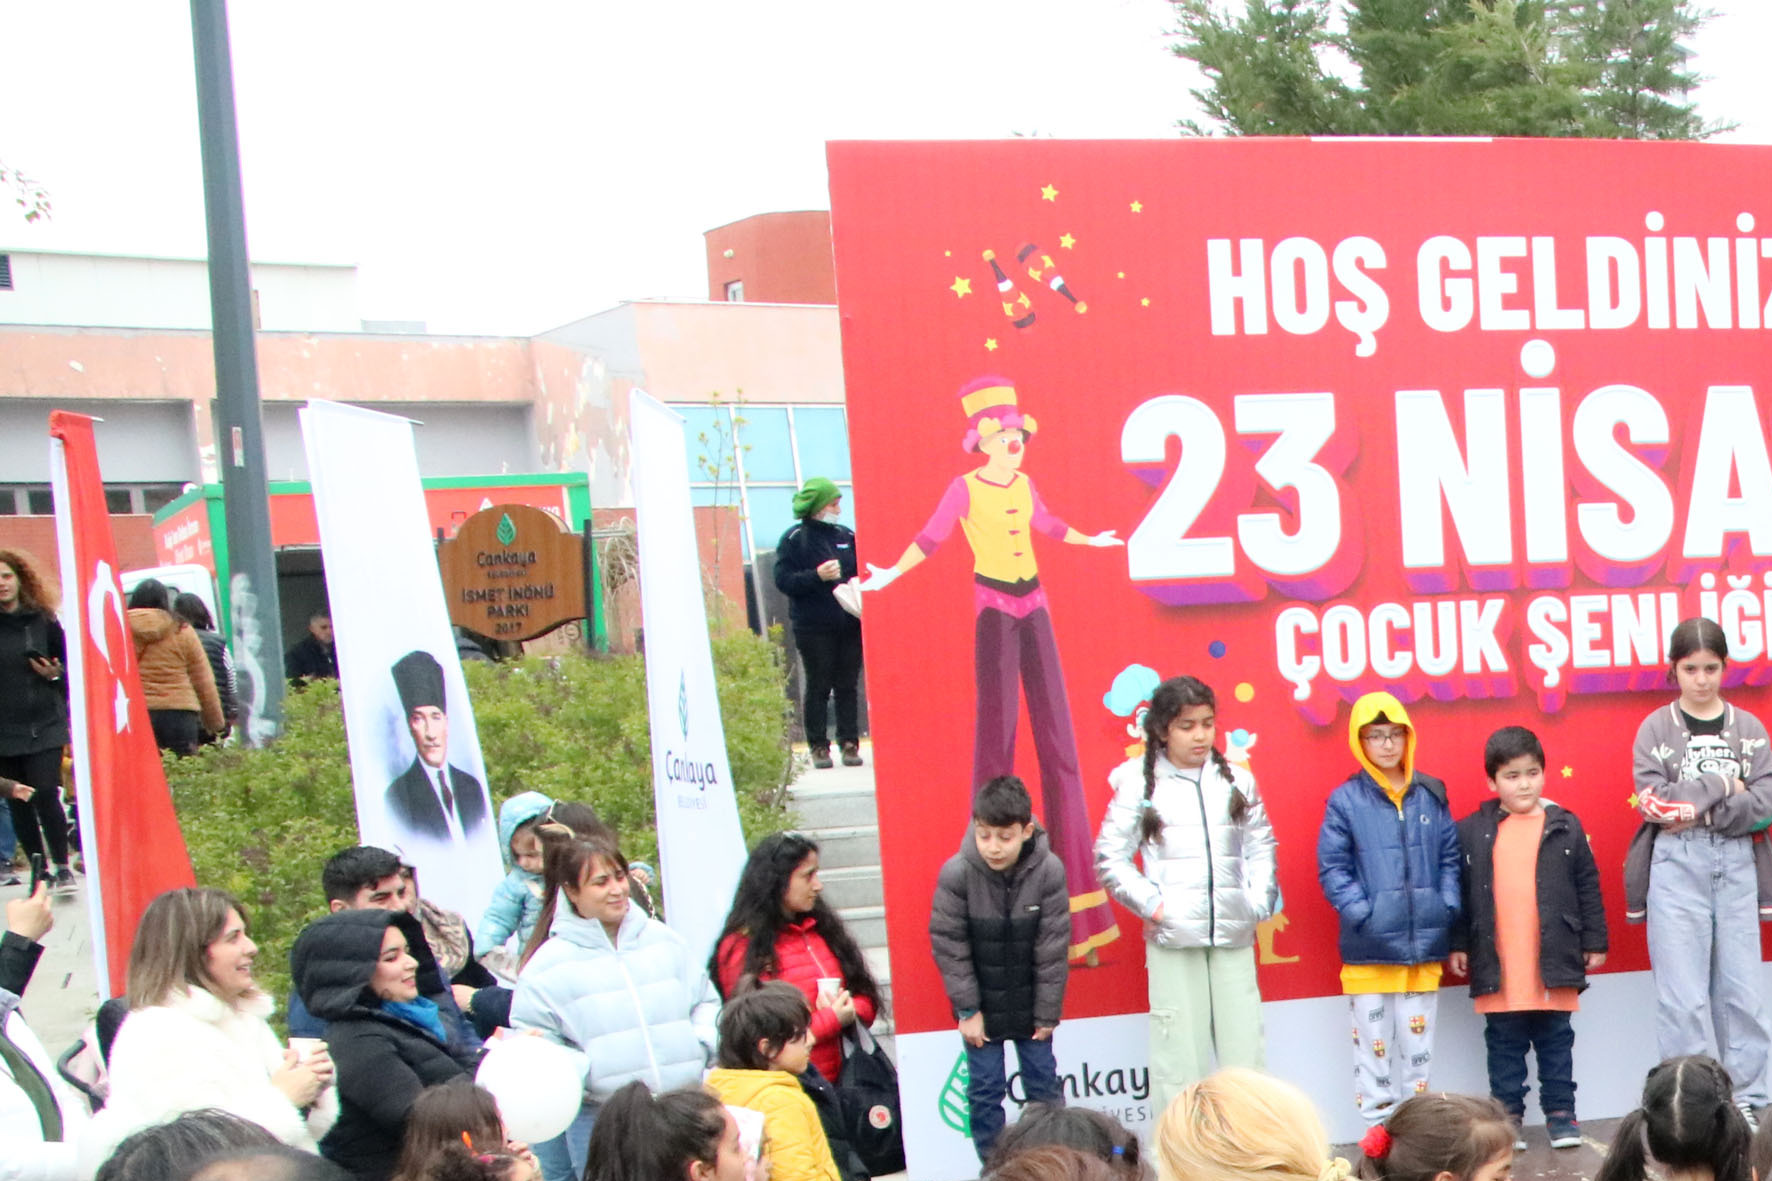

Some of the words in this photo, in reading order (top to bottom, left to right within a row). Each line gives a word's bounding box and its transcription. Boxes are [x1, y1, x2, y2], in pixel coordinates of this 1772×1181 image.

[1207, 236, 1390, 358] HOŞ
[1120, 391, 1342, 581] 23
[487, 603, 530, 619] PARKI
[495, 622, 523, 635] 2017
[1275, 597, 1509, 702] ÇOCUK
